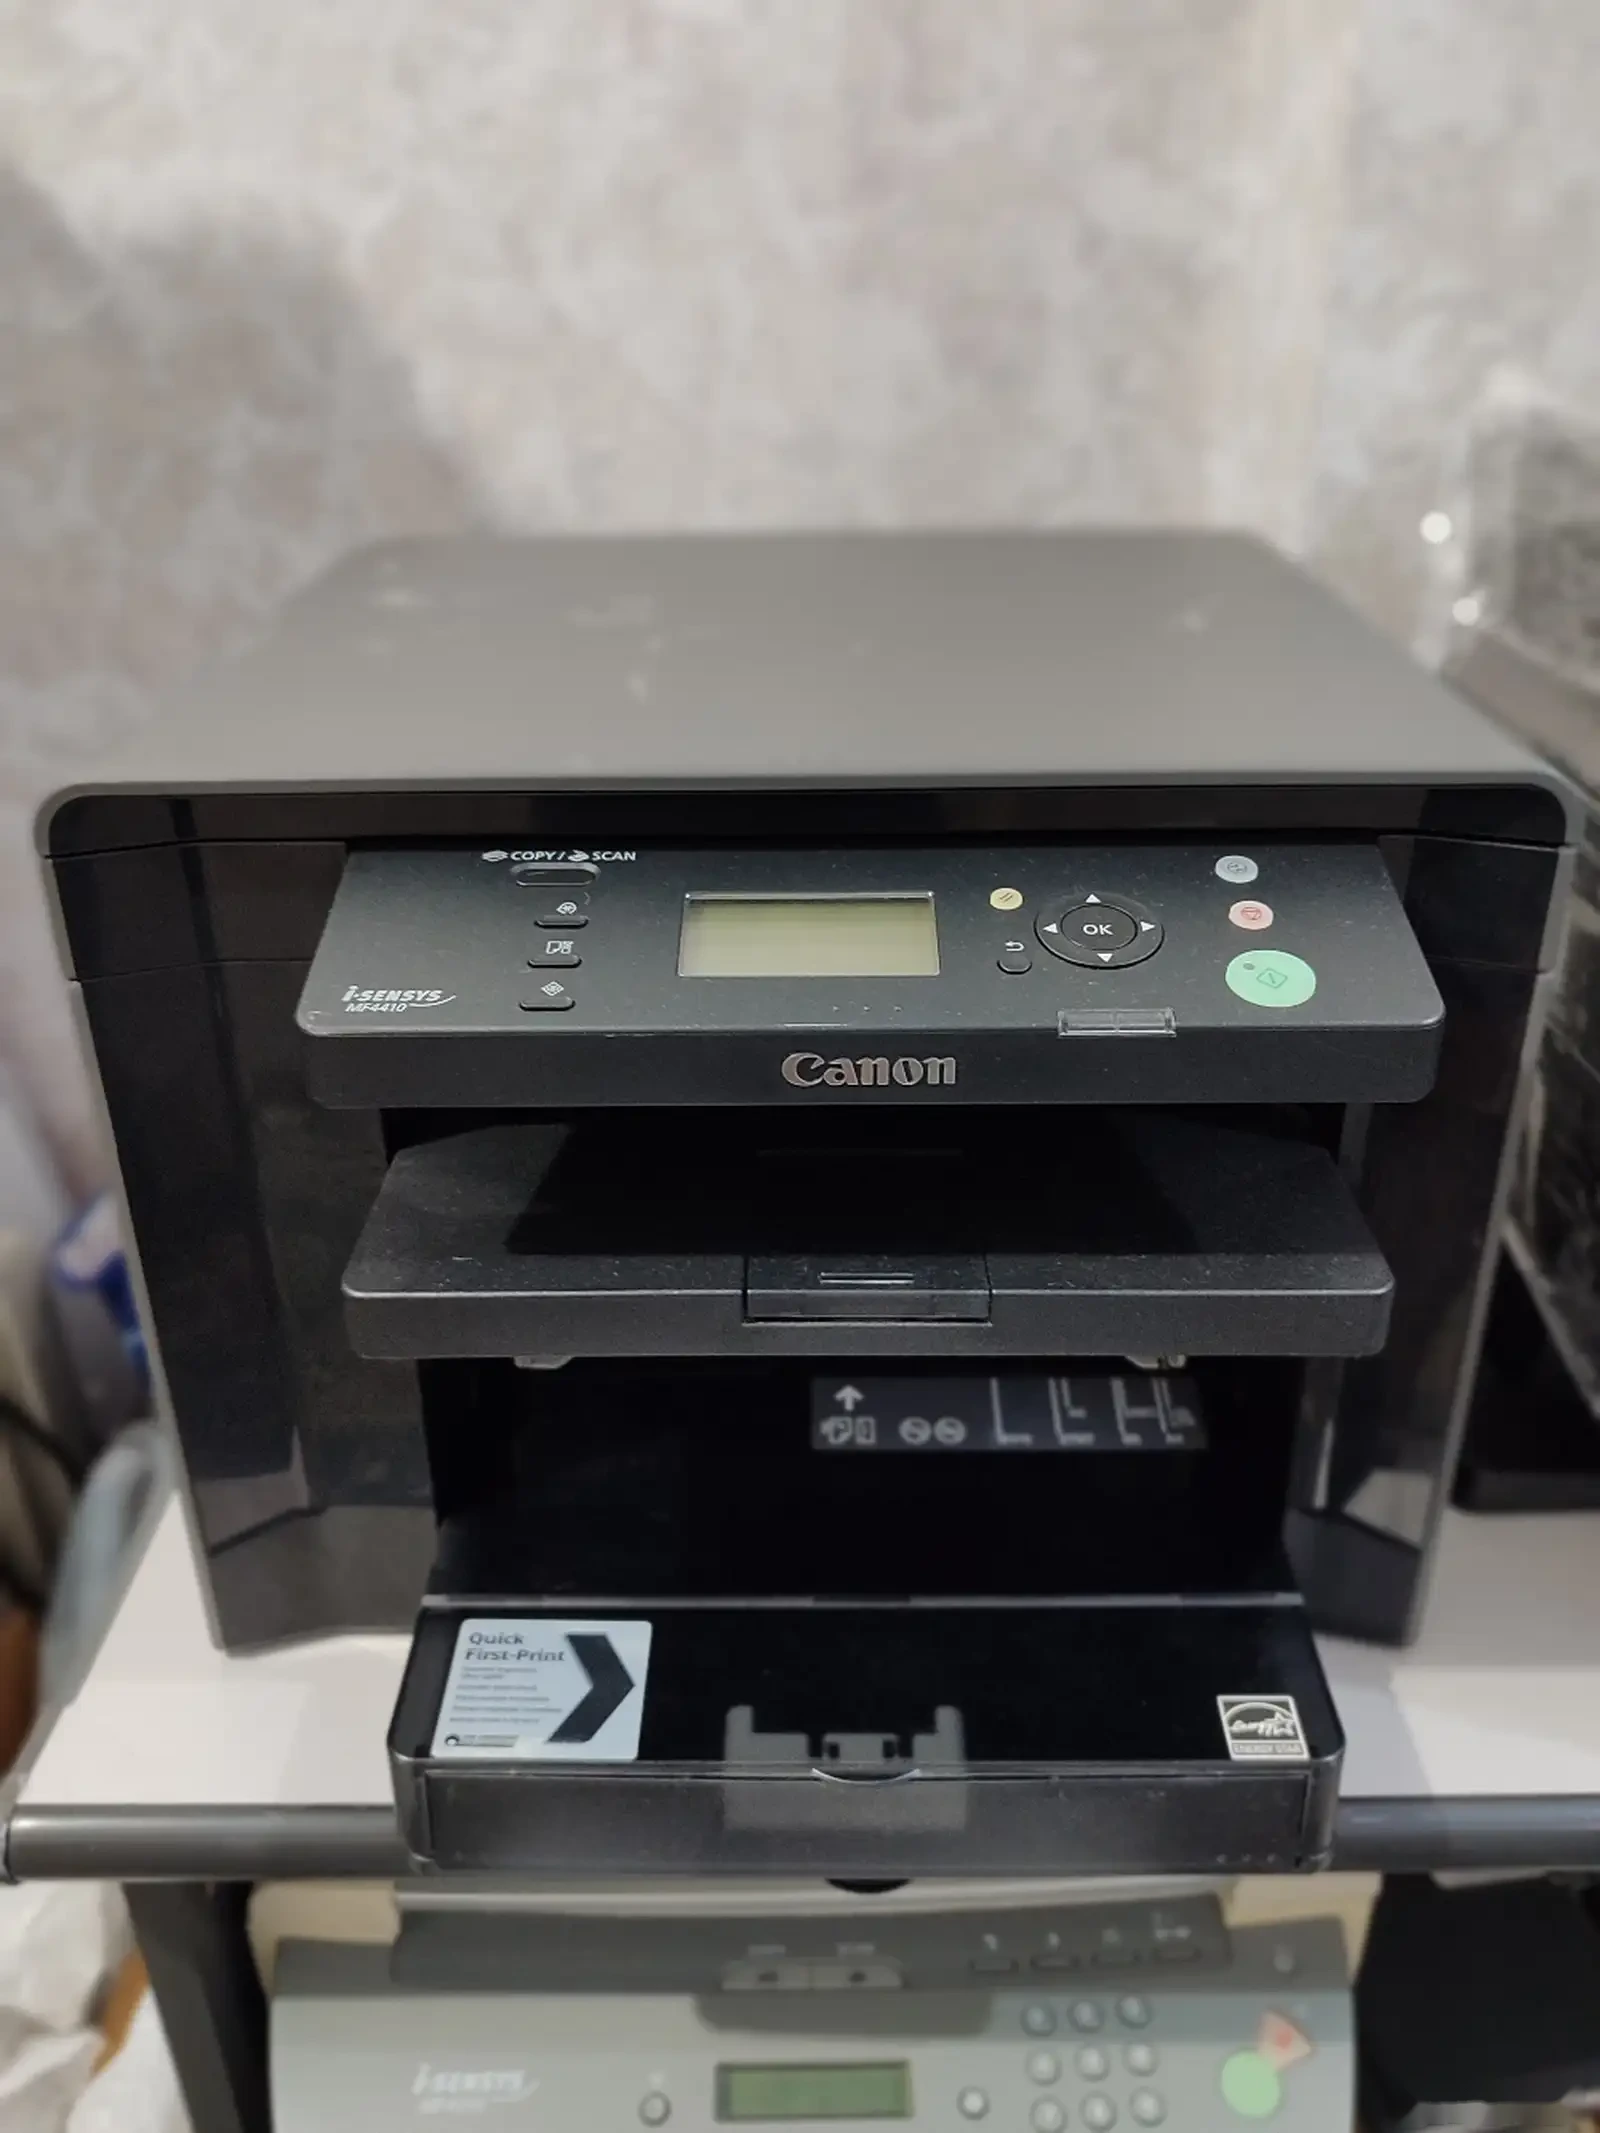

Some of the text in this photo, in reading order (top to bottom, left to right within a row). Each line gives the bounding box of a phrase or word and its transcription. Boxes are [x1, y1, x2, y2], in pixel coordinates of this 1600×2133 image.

[592, 851, 636, 861] SCAN
[1083, 924, 1114, 935] OK
[345, 1003, 408, 1012] MF4410
[781, 1052, 956, 1087] Canon
[469, 1632, 524, 1645] Quick
[465, 1648, 566, 1661] First-Print
